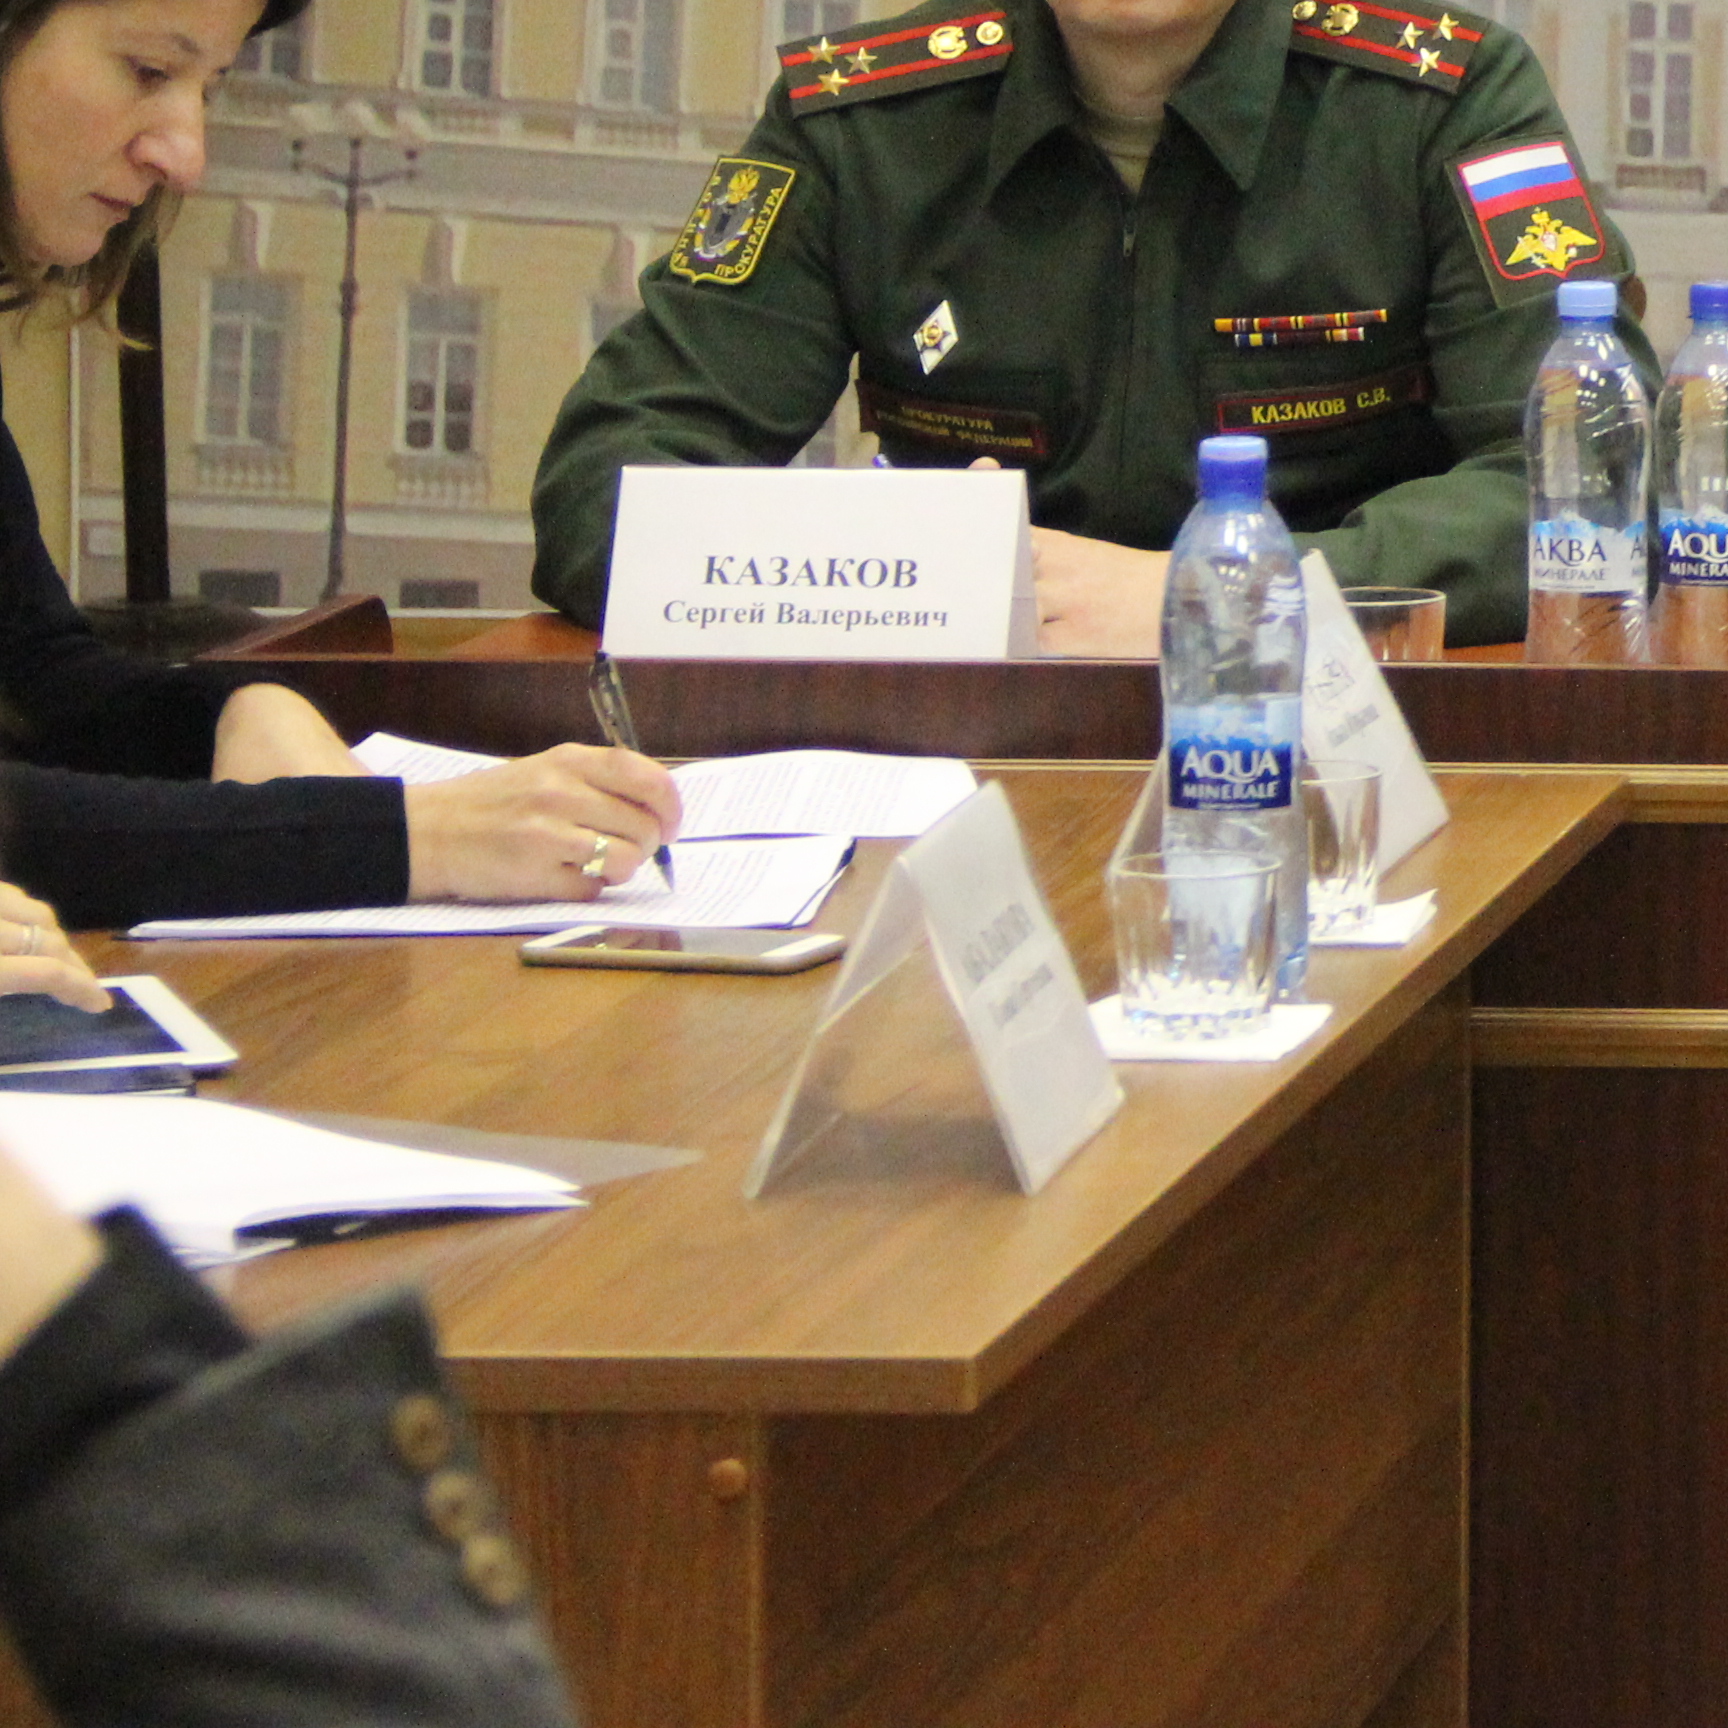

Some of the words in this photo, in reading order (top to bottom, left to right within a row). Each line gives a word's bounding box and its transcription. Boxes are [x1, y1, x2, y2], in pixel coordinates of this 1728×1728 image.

[714, 187, 783, 277] ПРОКУРАТУРА
[1251, 398, 1346, 424] КАЗАКОВ
[1356, 387, 1392, 408] С.В.
[1534, 535, 1607, 567] АКВА
[702, 555, 918, 588] КАЗАКОВ
[663, 600, 765, 629] Сергей
[776, 602, 949, 632] Валерьевич
[1180, 745, 1280, 784] AQUA
[1182, 780, 1280, 800] MINERALE
